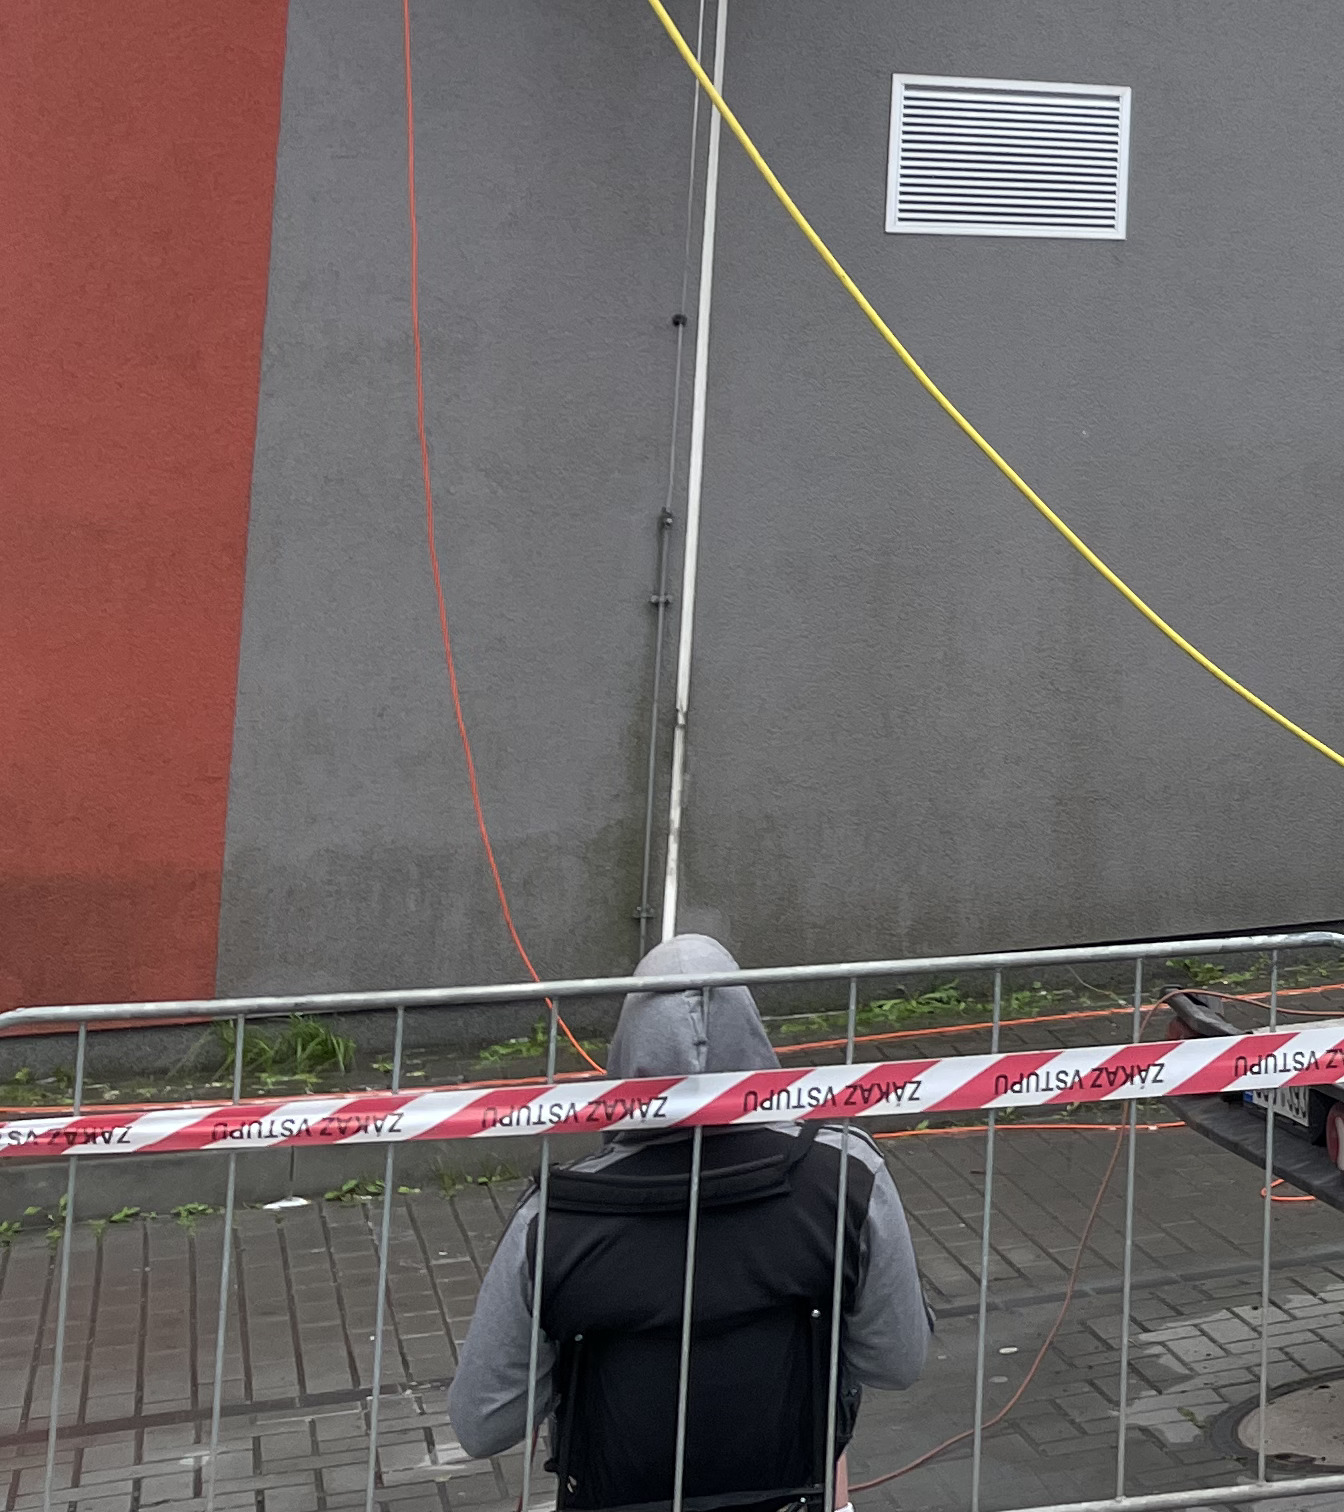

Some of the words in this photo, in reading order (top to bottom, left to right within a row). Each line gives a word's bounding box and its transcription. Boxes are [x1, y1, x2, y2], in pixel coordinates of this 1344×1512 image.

[1091, 1062, 1166, 1090] ZÁKAZ
[1234, 1051, 1318, 1077] VSTUPU
[845, 1080, 923, 1108] ZÁKAZ
[994, 1069, 1082, 1096] VSTUPU
[586, 1096, 668, 1124] ZÁKAZ
[743, 1086, 837, 1113] VSTUPU
[482, 1102, 578, 1128] VSTUPU
[211, 1119, 309, 1142] VSTUPU
